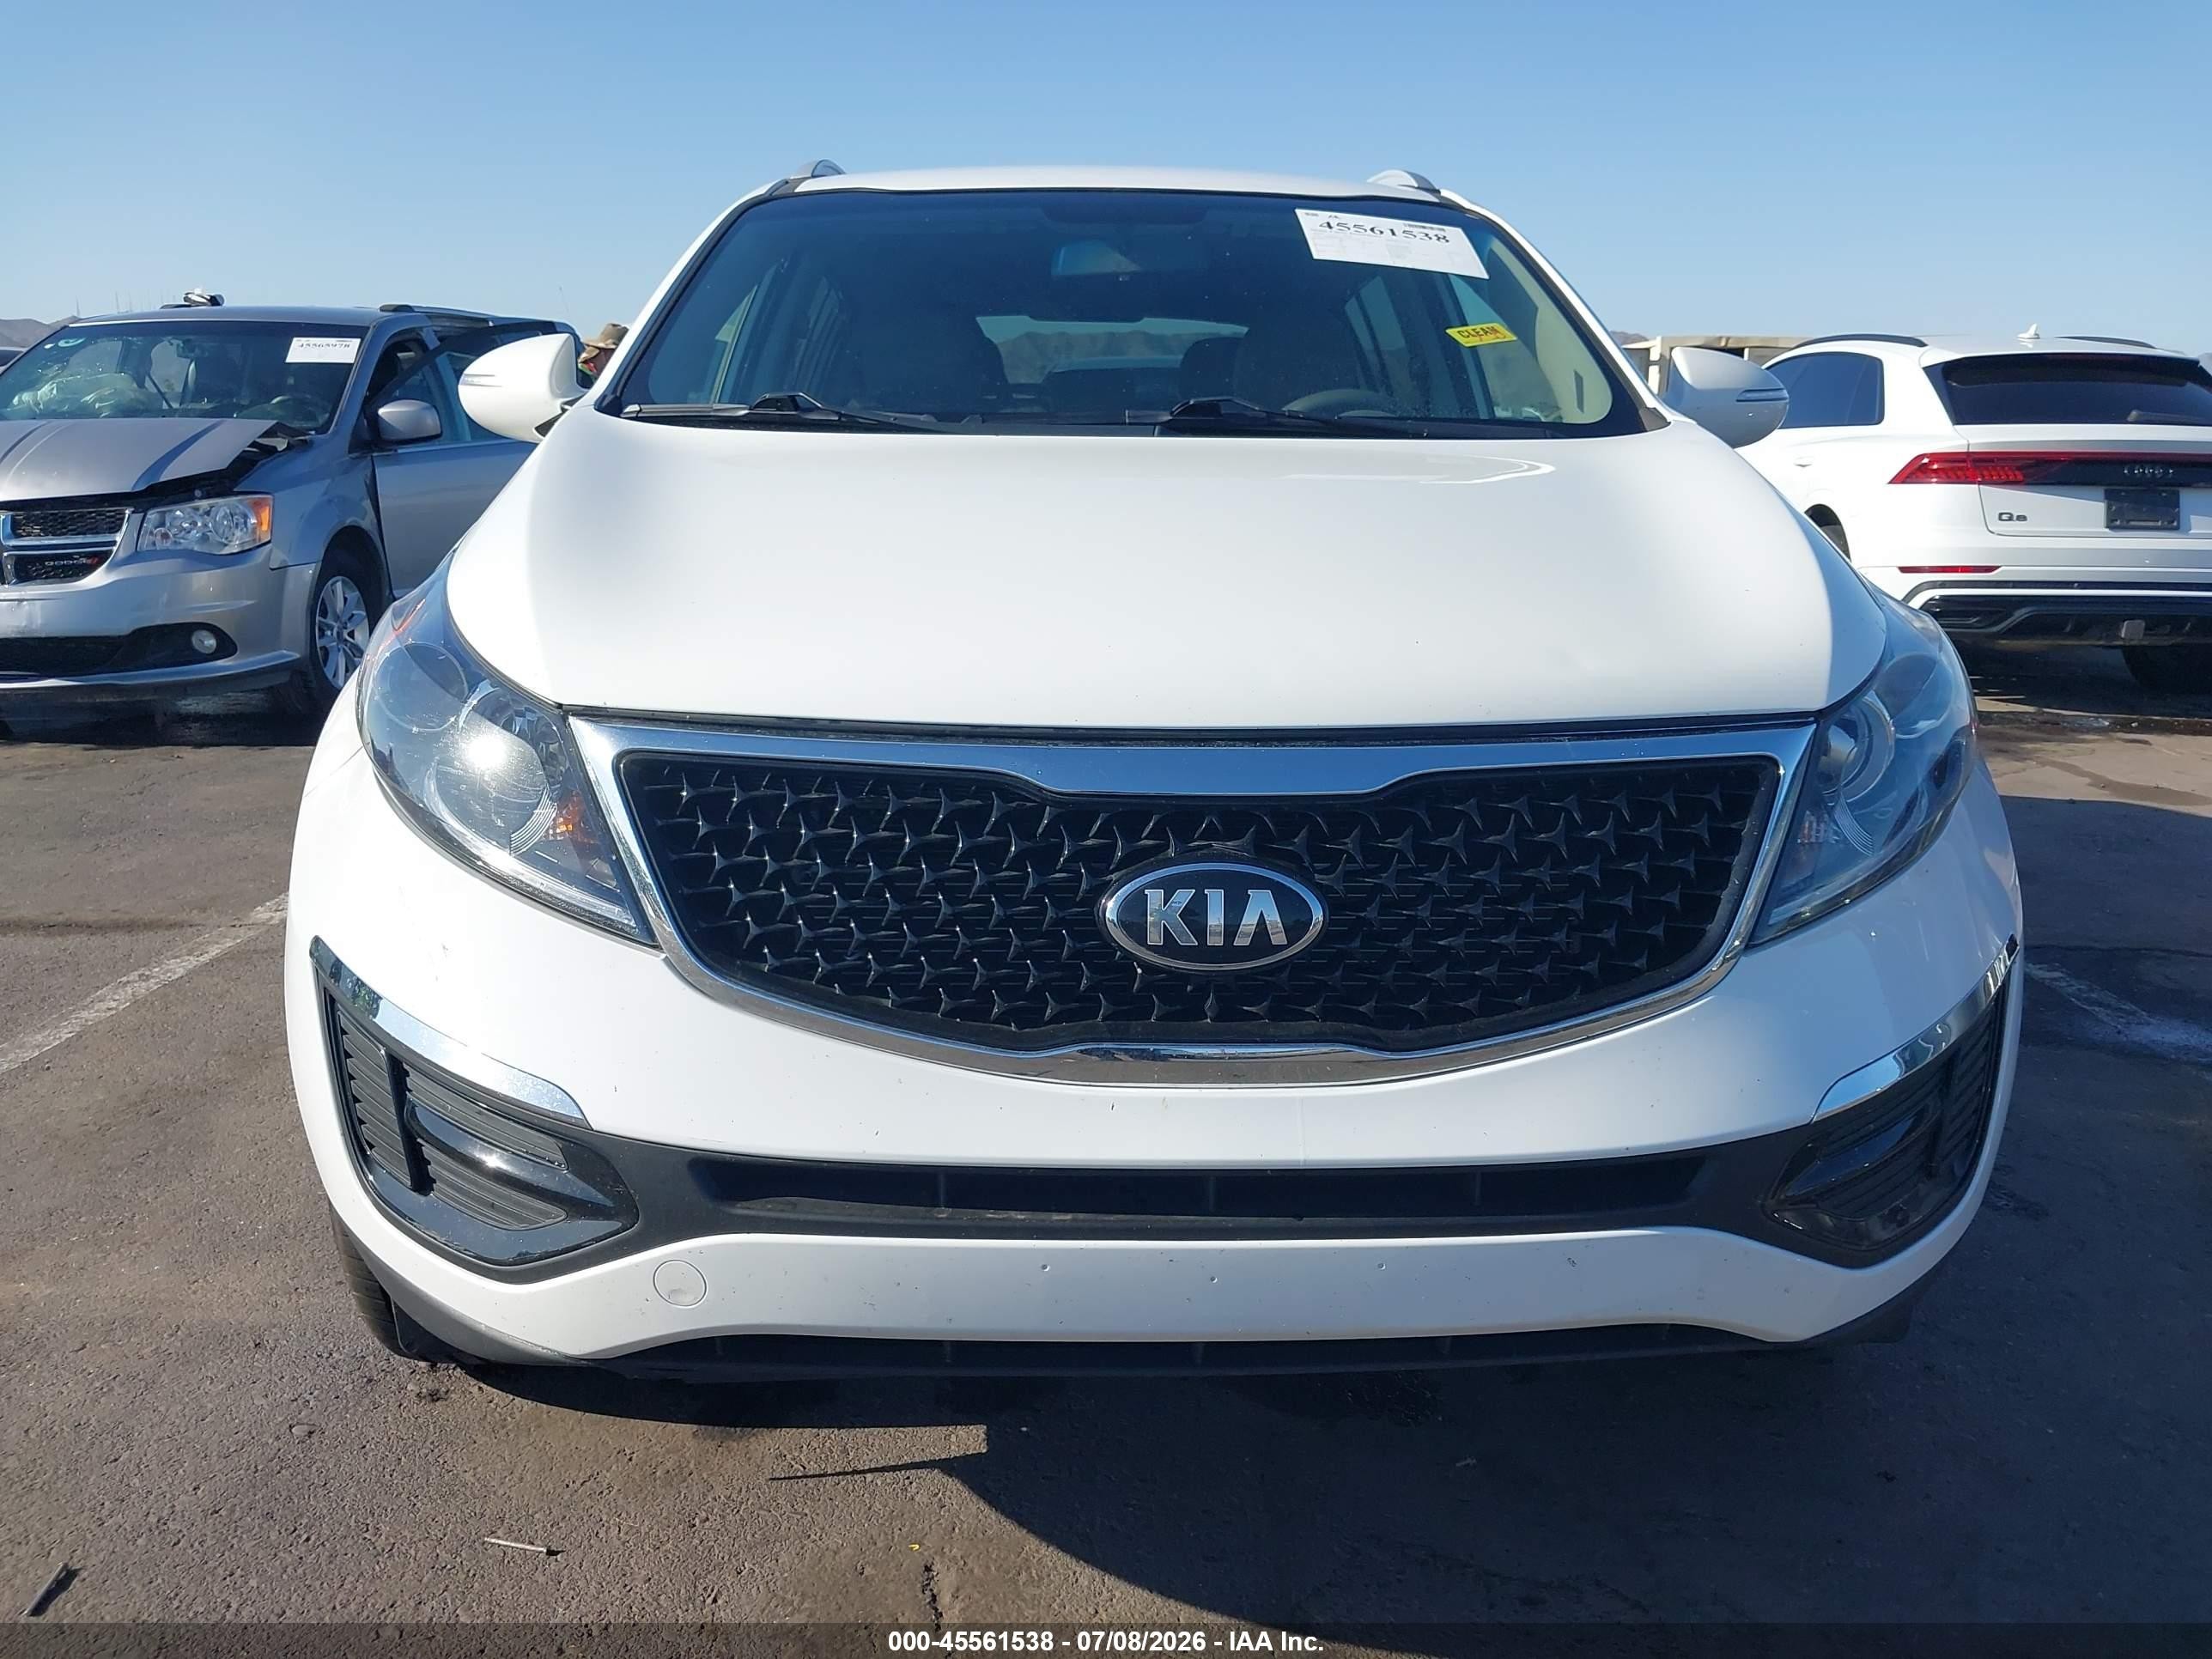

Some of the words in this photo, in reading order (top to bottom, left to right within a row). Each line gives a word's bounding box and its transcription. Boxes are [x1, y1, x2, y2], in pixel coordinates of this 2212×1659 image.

[1318, 220, 1450, 244] 45561538
[1456, 325, 1499, 338] CLEAN
[1998, 512, 2027, 521] Q8
[1145, 889, 1288, 946] KIA
